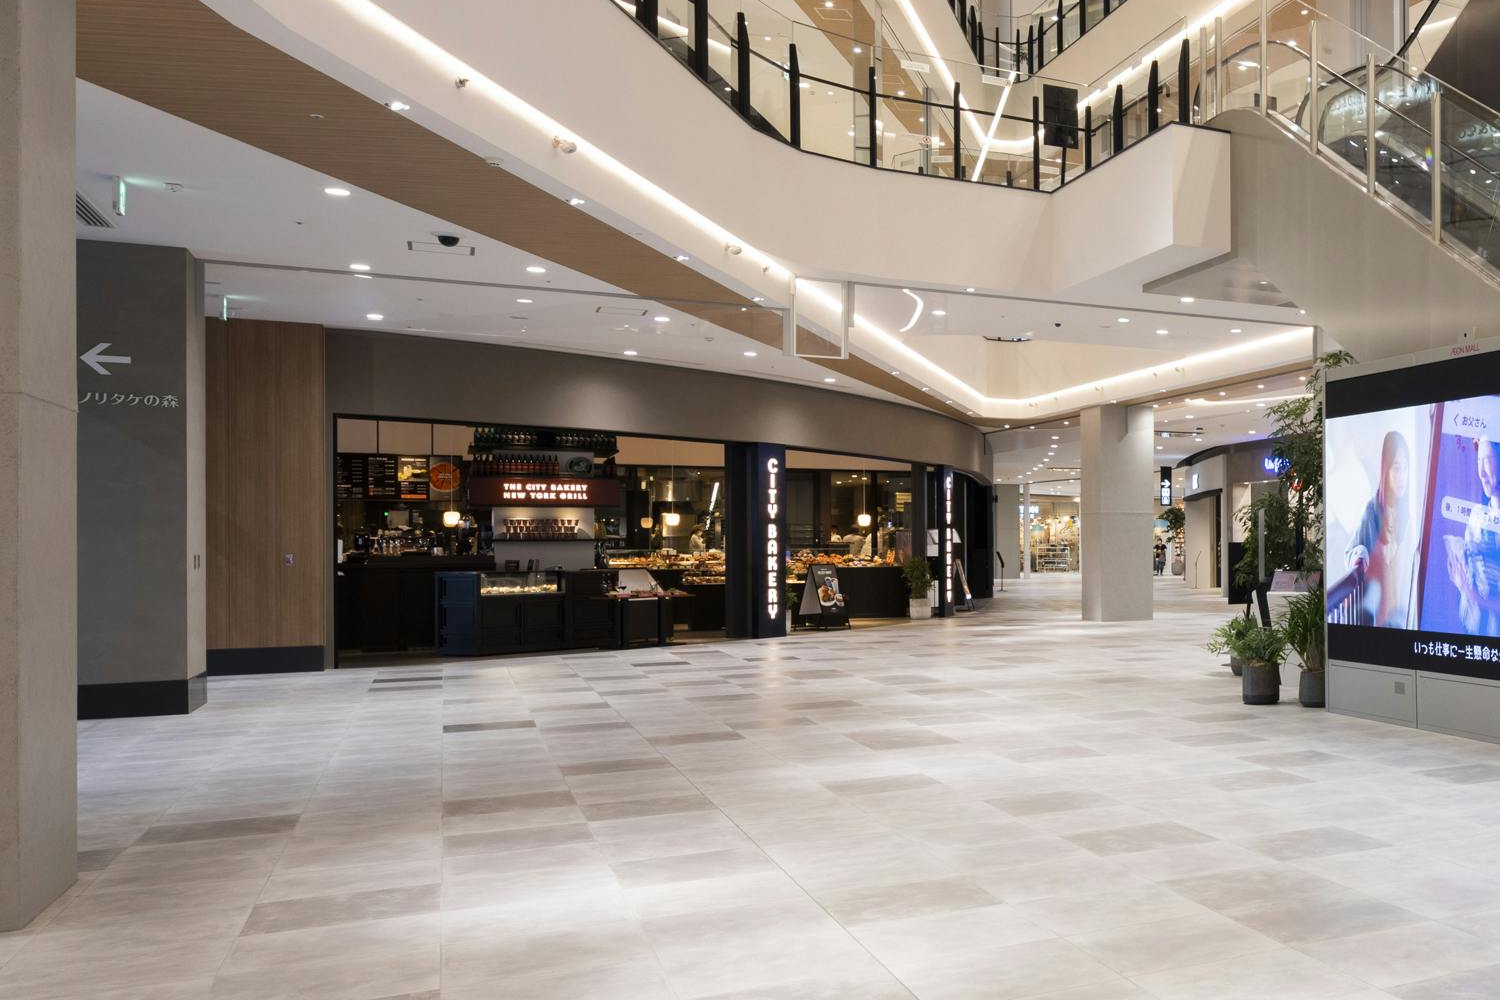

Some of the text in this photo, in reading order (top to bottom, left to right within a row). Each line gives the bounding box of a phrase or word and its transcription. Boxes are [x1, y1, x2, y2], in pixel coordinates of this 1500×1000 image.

[79, 392, 180, 408] ノリタケの森
[1462, 415, 1487, 429] お父さん
[503, 483, 588, 492] THE CITY BAKERY
[559, 492, 588, 500] GRILL
[767, 458, 779, 620] CITY BAKERY
